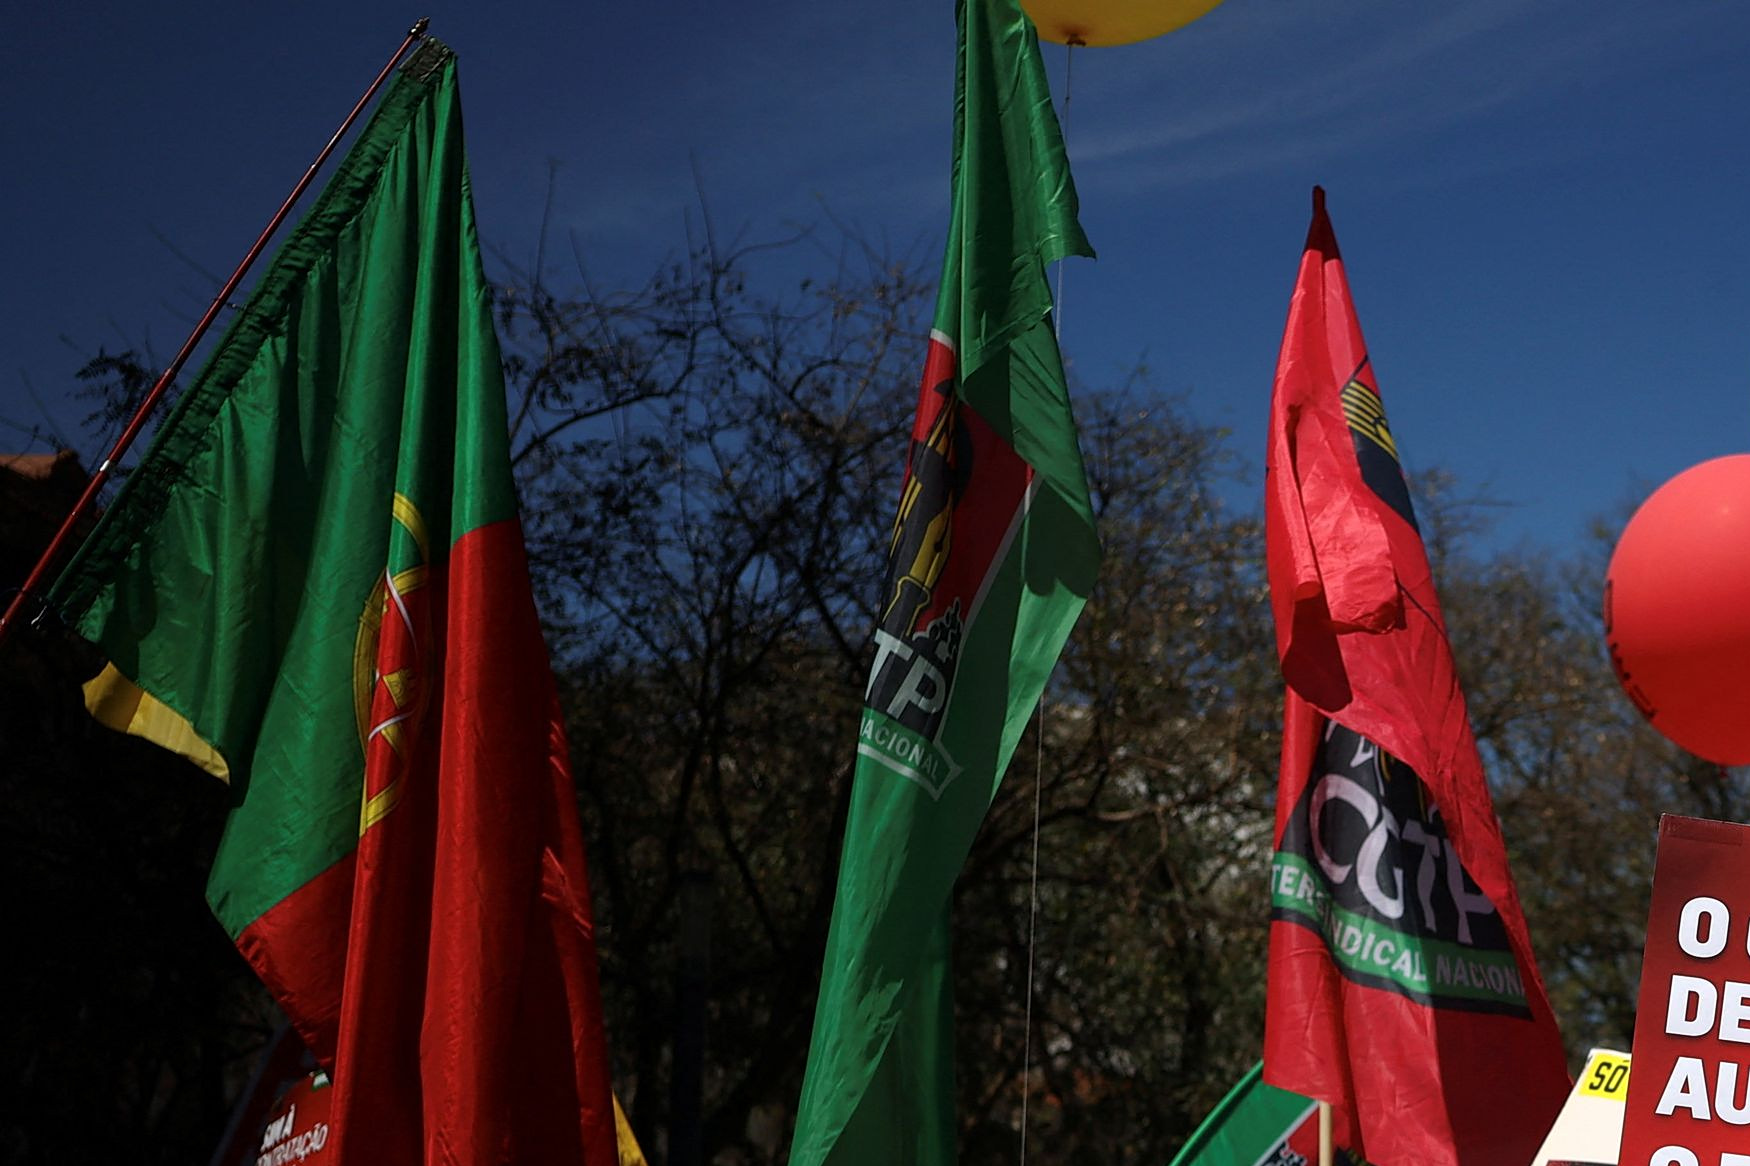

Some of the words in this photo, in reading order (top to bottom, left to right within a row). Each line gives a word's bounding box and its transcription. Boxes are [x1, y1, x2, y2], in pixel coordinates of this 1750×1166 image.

[865, 628, 946, 719] TP
[1678, 897, 1730, 958] O
[1436, 954, 1525, 996] NACION
